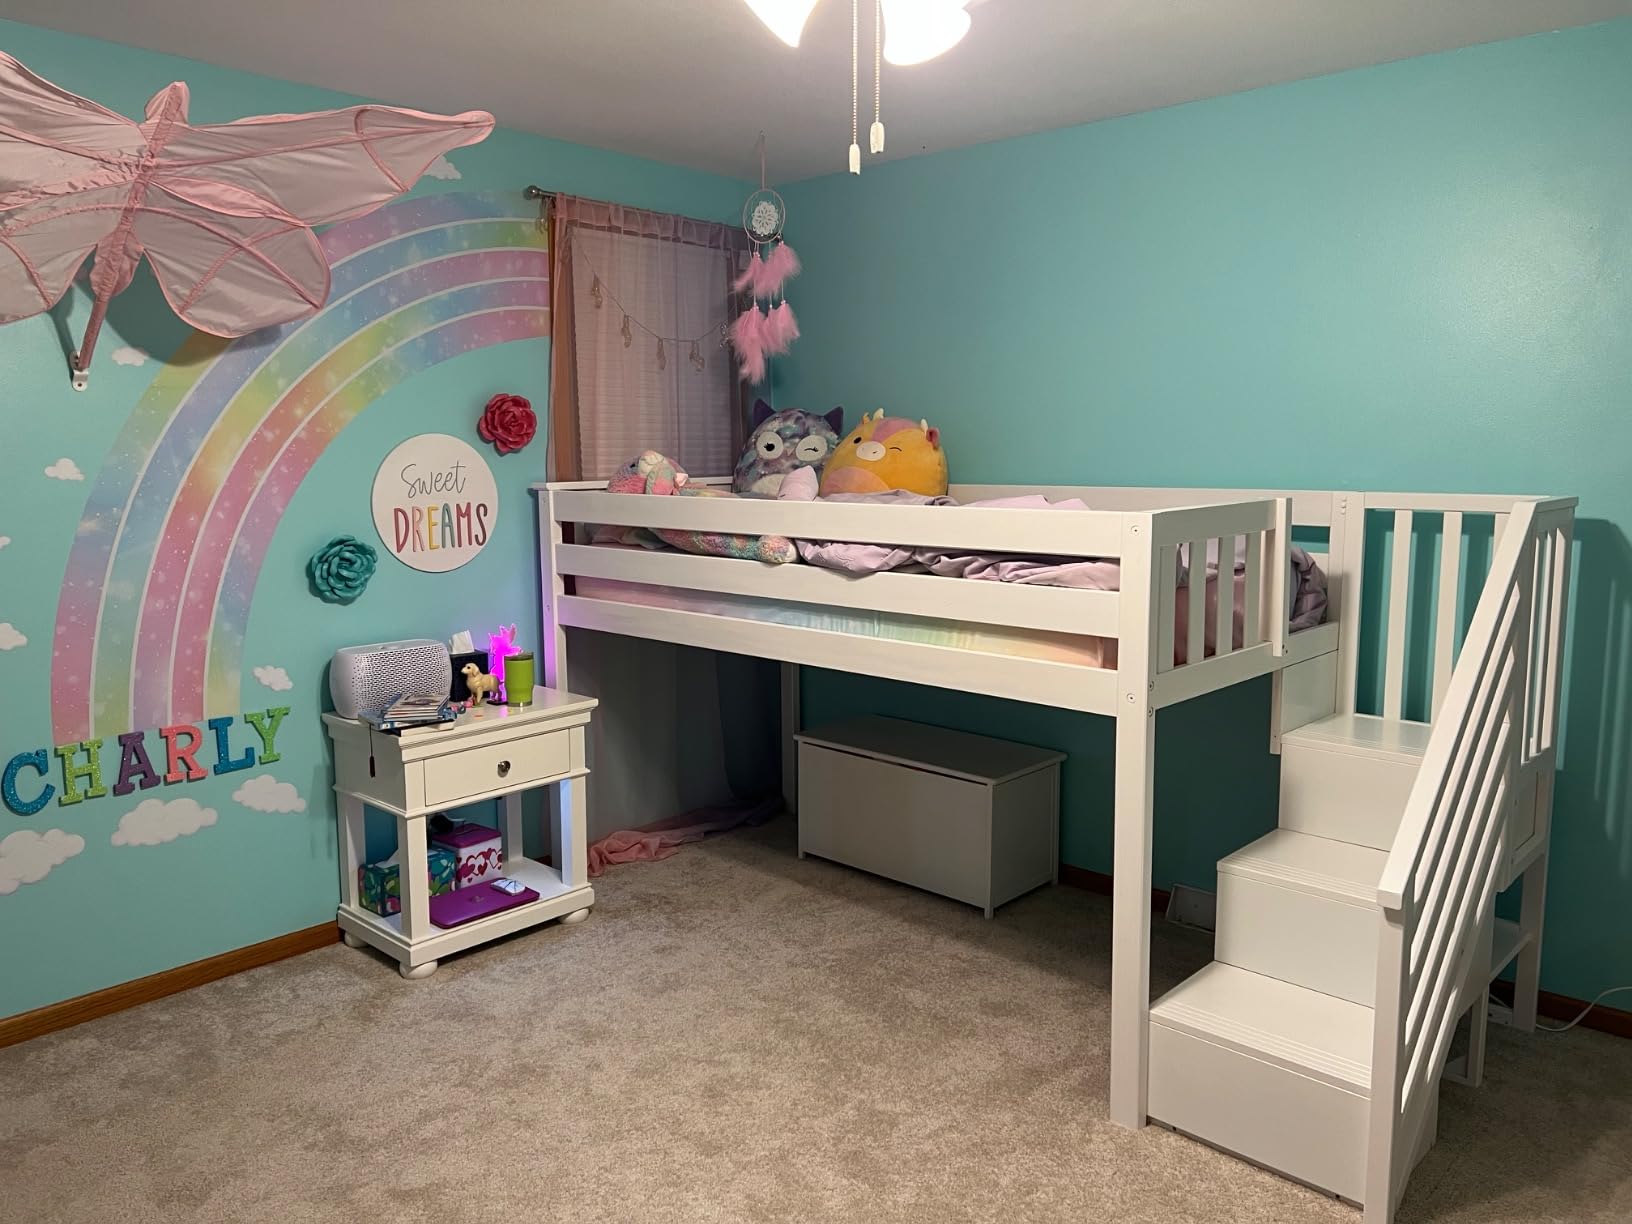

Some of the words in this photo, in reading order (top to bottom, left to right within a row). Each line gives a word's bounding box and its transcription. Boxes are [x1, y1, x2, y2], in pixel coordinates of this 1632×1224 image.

[400, 461, 466, 499] Sweet
[393, 502, 489, 554] DREAMS
[1, 707, 291, 816] CHARLY
